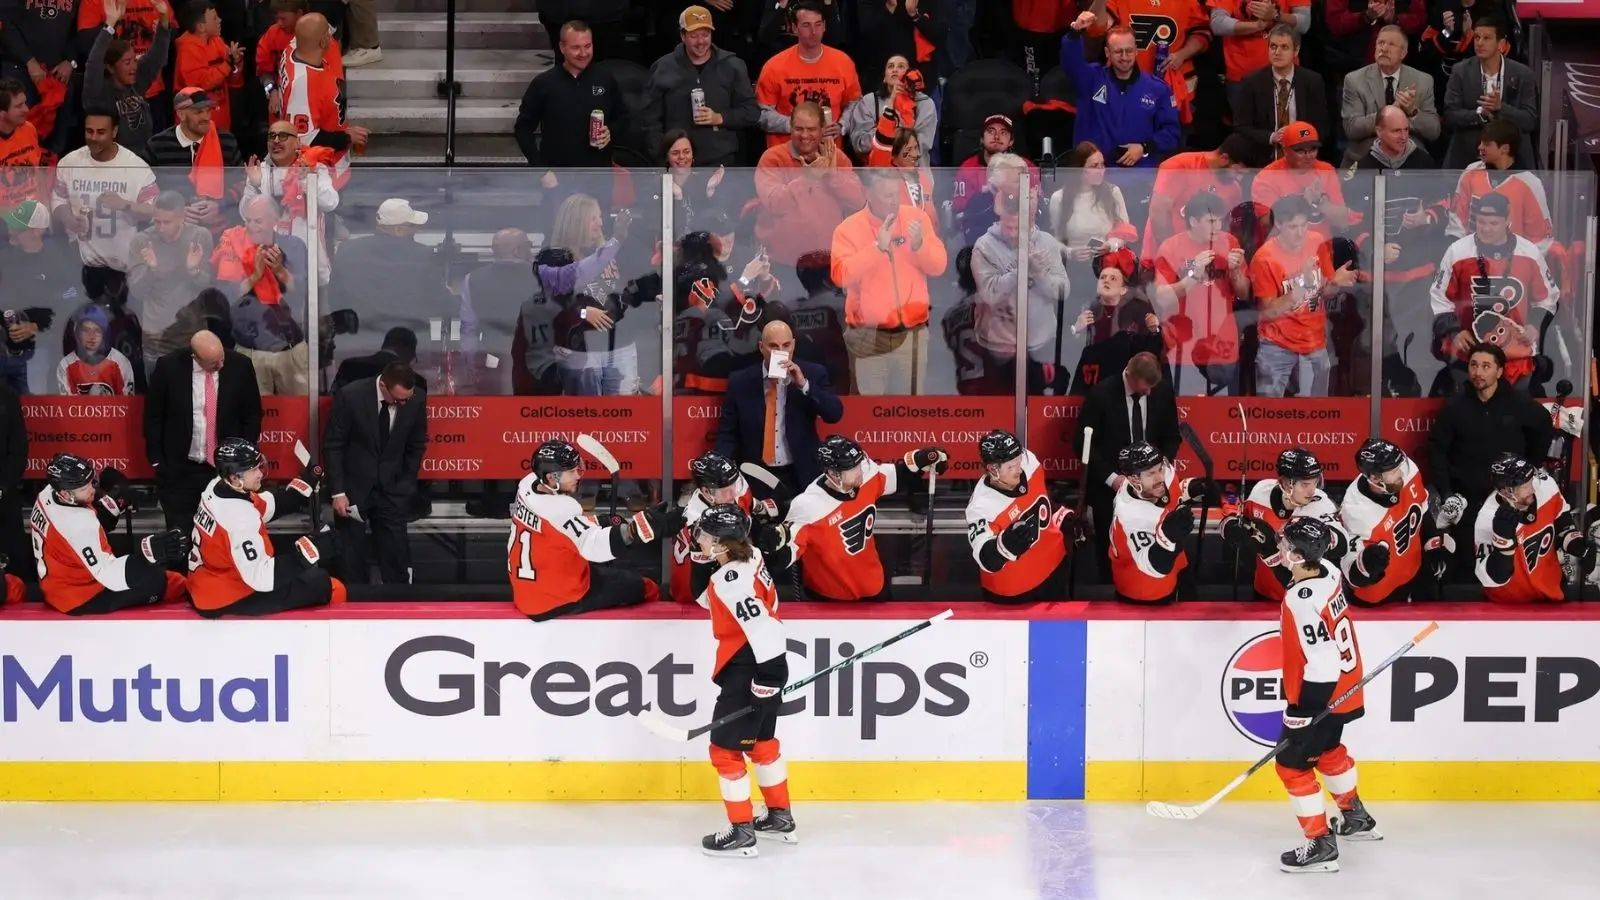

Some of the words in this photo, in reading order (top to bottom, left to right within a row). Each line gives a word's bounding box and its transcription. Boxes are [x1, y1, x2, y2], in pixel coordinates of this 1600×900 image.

[72, 180, 128, 194] CHAMPION
[953, 181, 966, 197] 20
[22, 405, 64, 418] ORNIA
[520, 406, 632, 418] CalClosets.com
[872, 406, 985, 418] CalClosets.com
[1228, 407, 1341, 419] CalClosets.com
[854, 430, 937, 443] CALIFORNIA
[1210, 431, 1293, 444] CALIFORNIA
[1409, 484, 1418, 498] C
[194, 508, 216, 533] HEIM
[563, 515, 590, 538] 71
[968, 518, 986, 542] 22
[241, 540, 258, 561] 6
[1130, 531, 1152, 552] 19
[82, 546, 98, 567] 8
[736, 597, 761, 622] 46
[1303, 620, 1330, 645] 94
[384, 635, 697, 716] Great
[3, 654, 288, 722] Mutual
